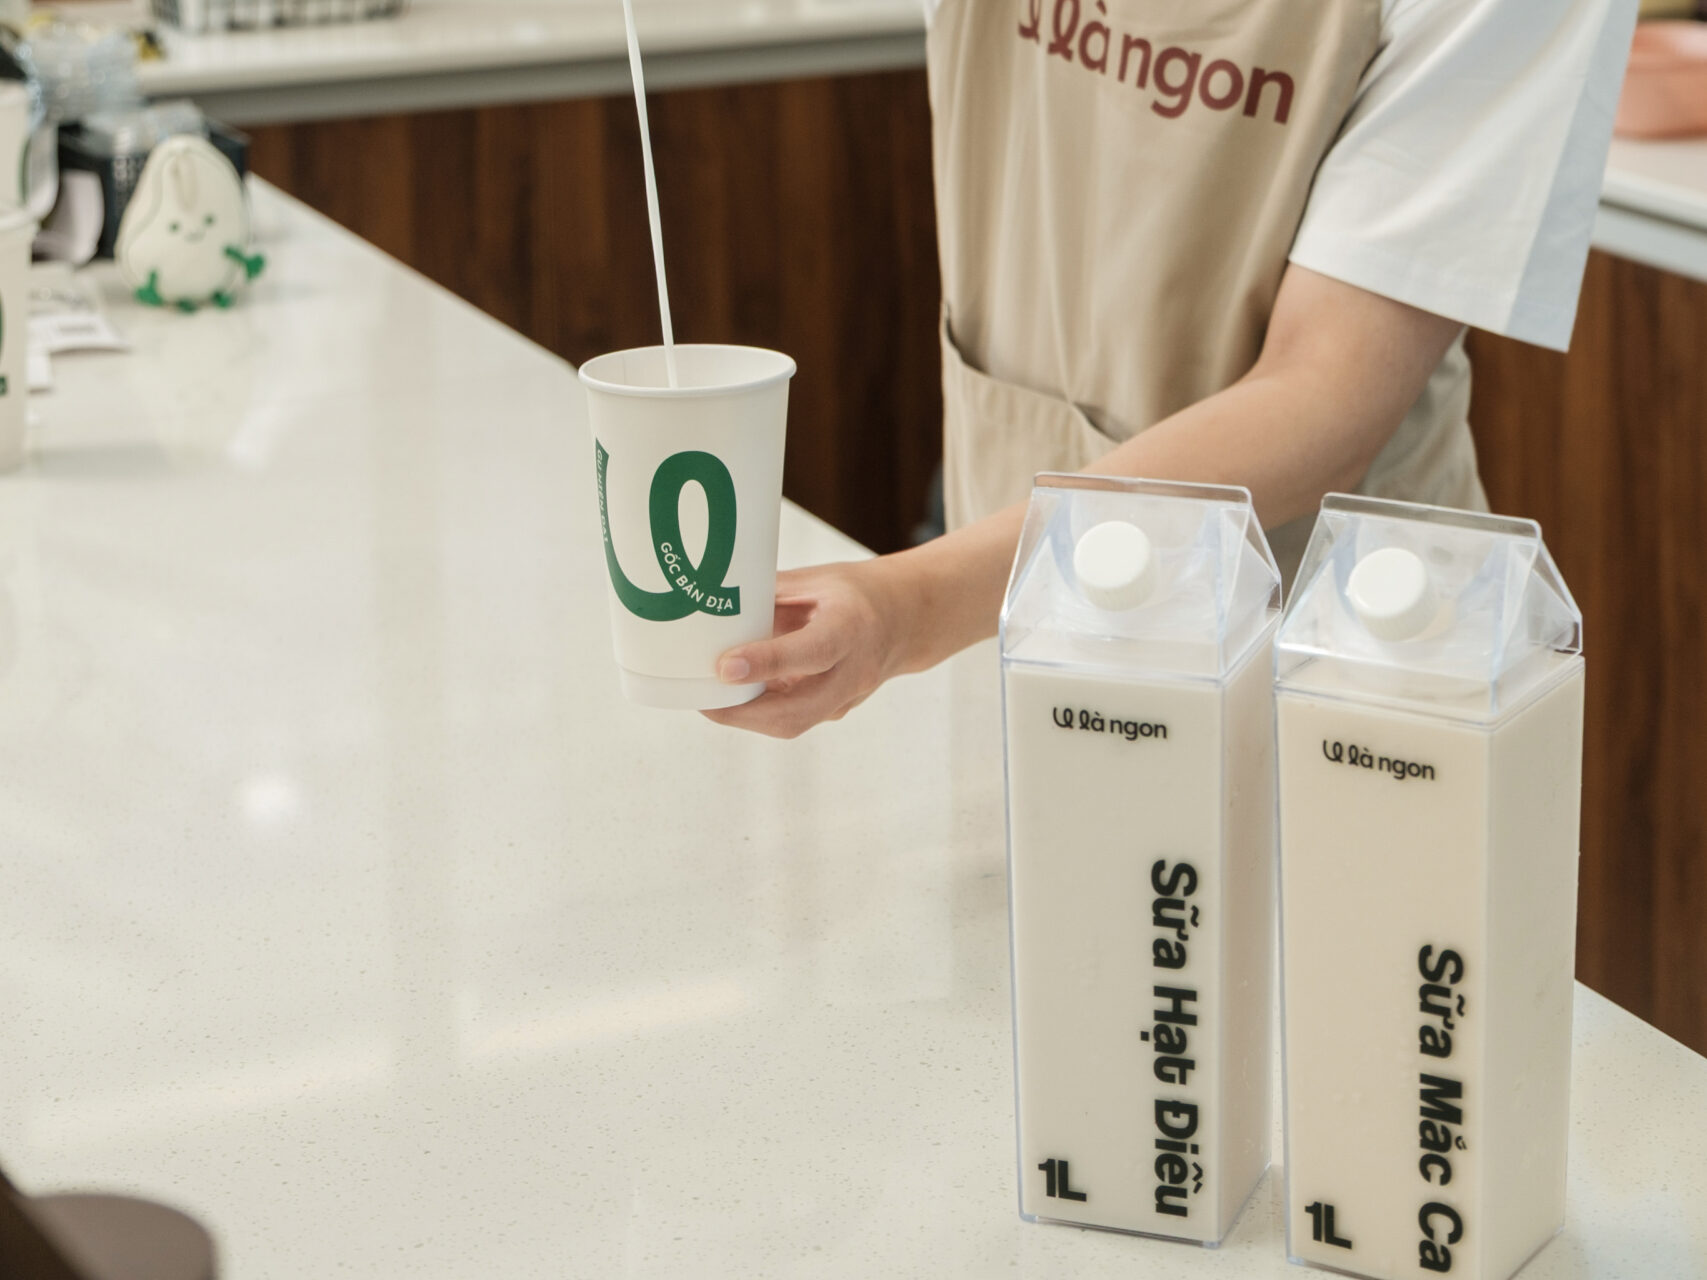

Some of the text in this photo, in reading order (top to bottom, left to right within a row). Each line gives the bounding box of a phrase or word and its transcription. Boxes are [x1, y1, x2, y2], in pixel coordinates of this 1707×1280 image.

[1117, 33, 1295, 125] ngon
[661, 542, 733, 612] GỐC BẢN ĐỊA
[1109, 719, 1167, 741] ngon
[1378, 756, 1435, 780] ngon
[1140, 859, 1204, 1218] Sữa Hạt Điều
[1418, 944, 1467, 1273] Sữa Mắc Ca
[1038, 1158, 1087, 1202] 1L
[1305, 1201, 1352, 1250] 1L
